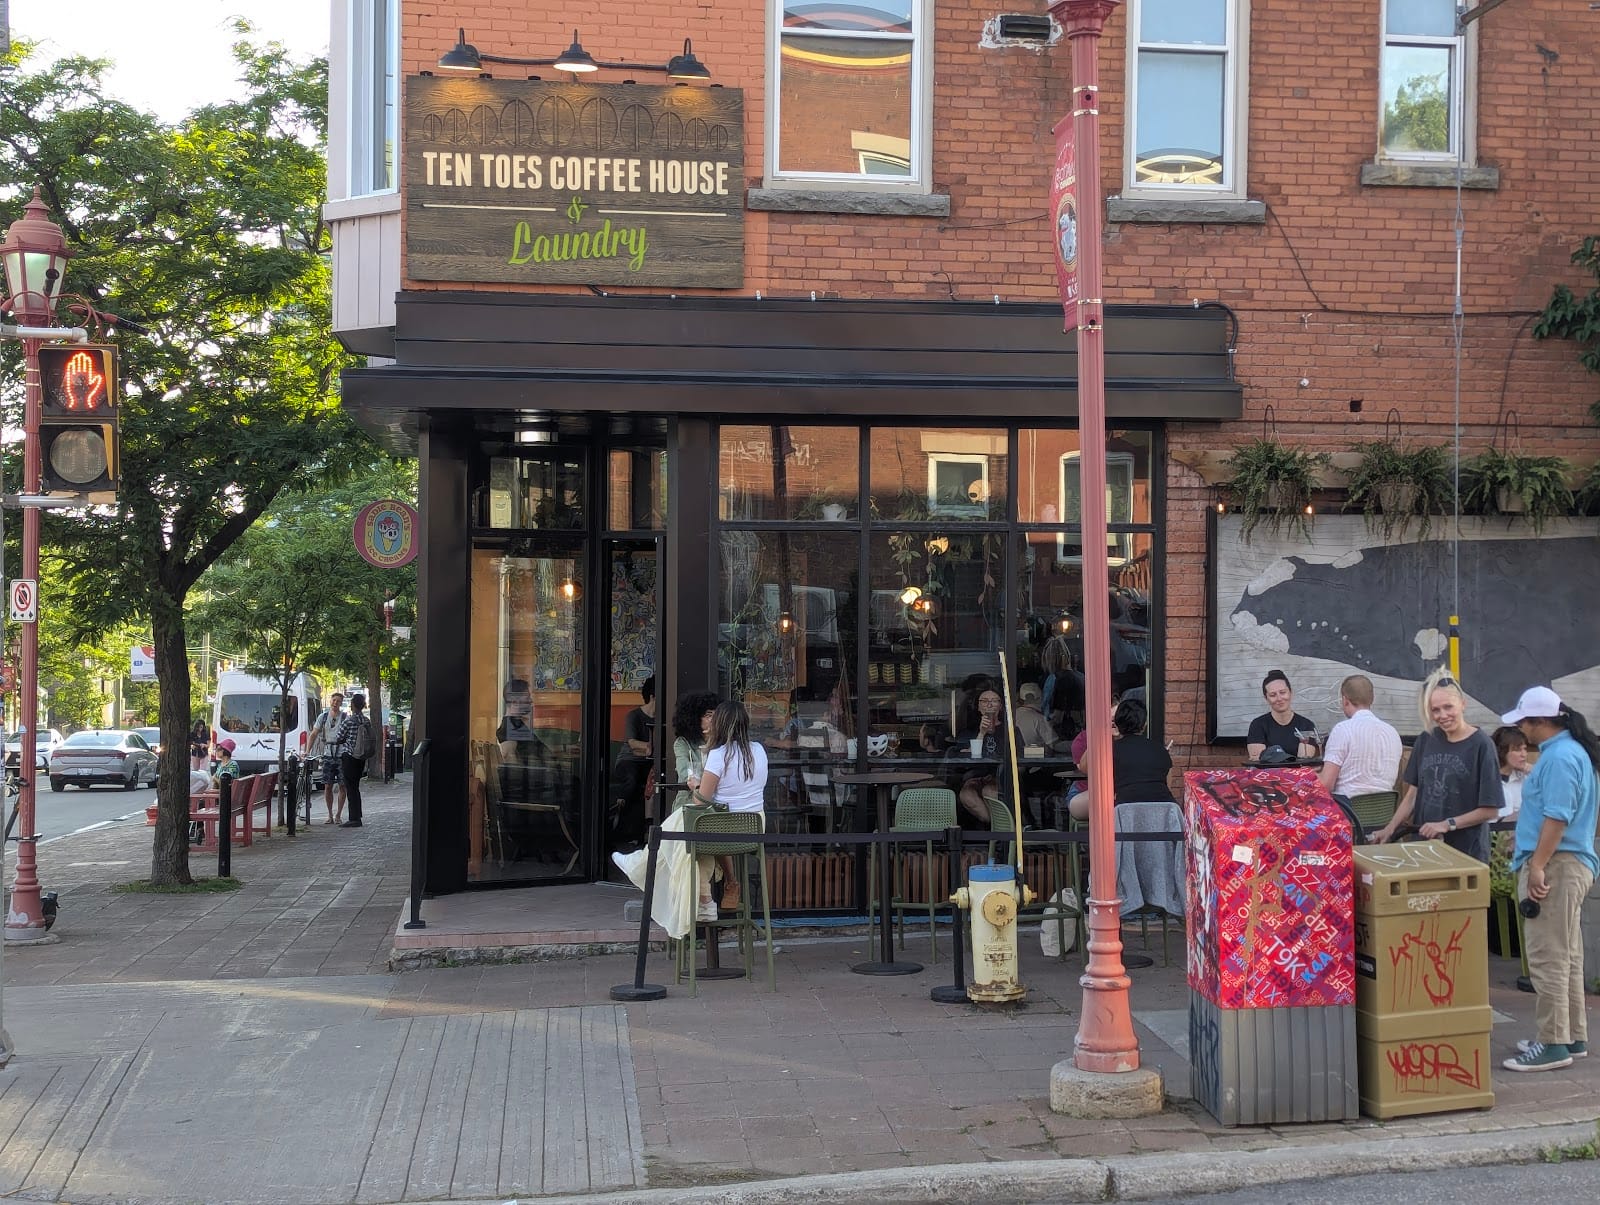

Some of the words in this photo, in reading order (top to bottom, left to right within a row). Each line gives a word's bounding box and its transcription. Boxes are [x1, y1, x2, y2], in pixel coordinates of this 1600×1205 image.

[423, 151, 472, 187] TEN
[480, 153, 543, 190] TOES
[550, 156, 642, 193] COFFEE
[649, 159, 729, 195] HOUSE
[566, 196, 588, 224] &
[508, 218, 650, 272] Laundry
[1220, 877, 1242, 902] A1B
[1284, 857, 1321, 892] B2Z
[1304, 914, 1339, 944] E4P
[1266, 935, 1307, 980] T9K
[1300, 951, 1334, 984] K4A
[1247, 969, 1283, 1005] H1X
